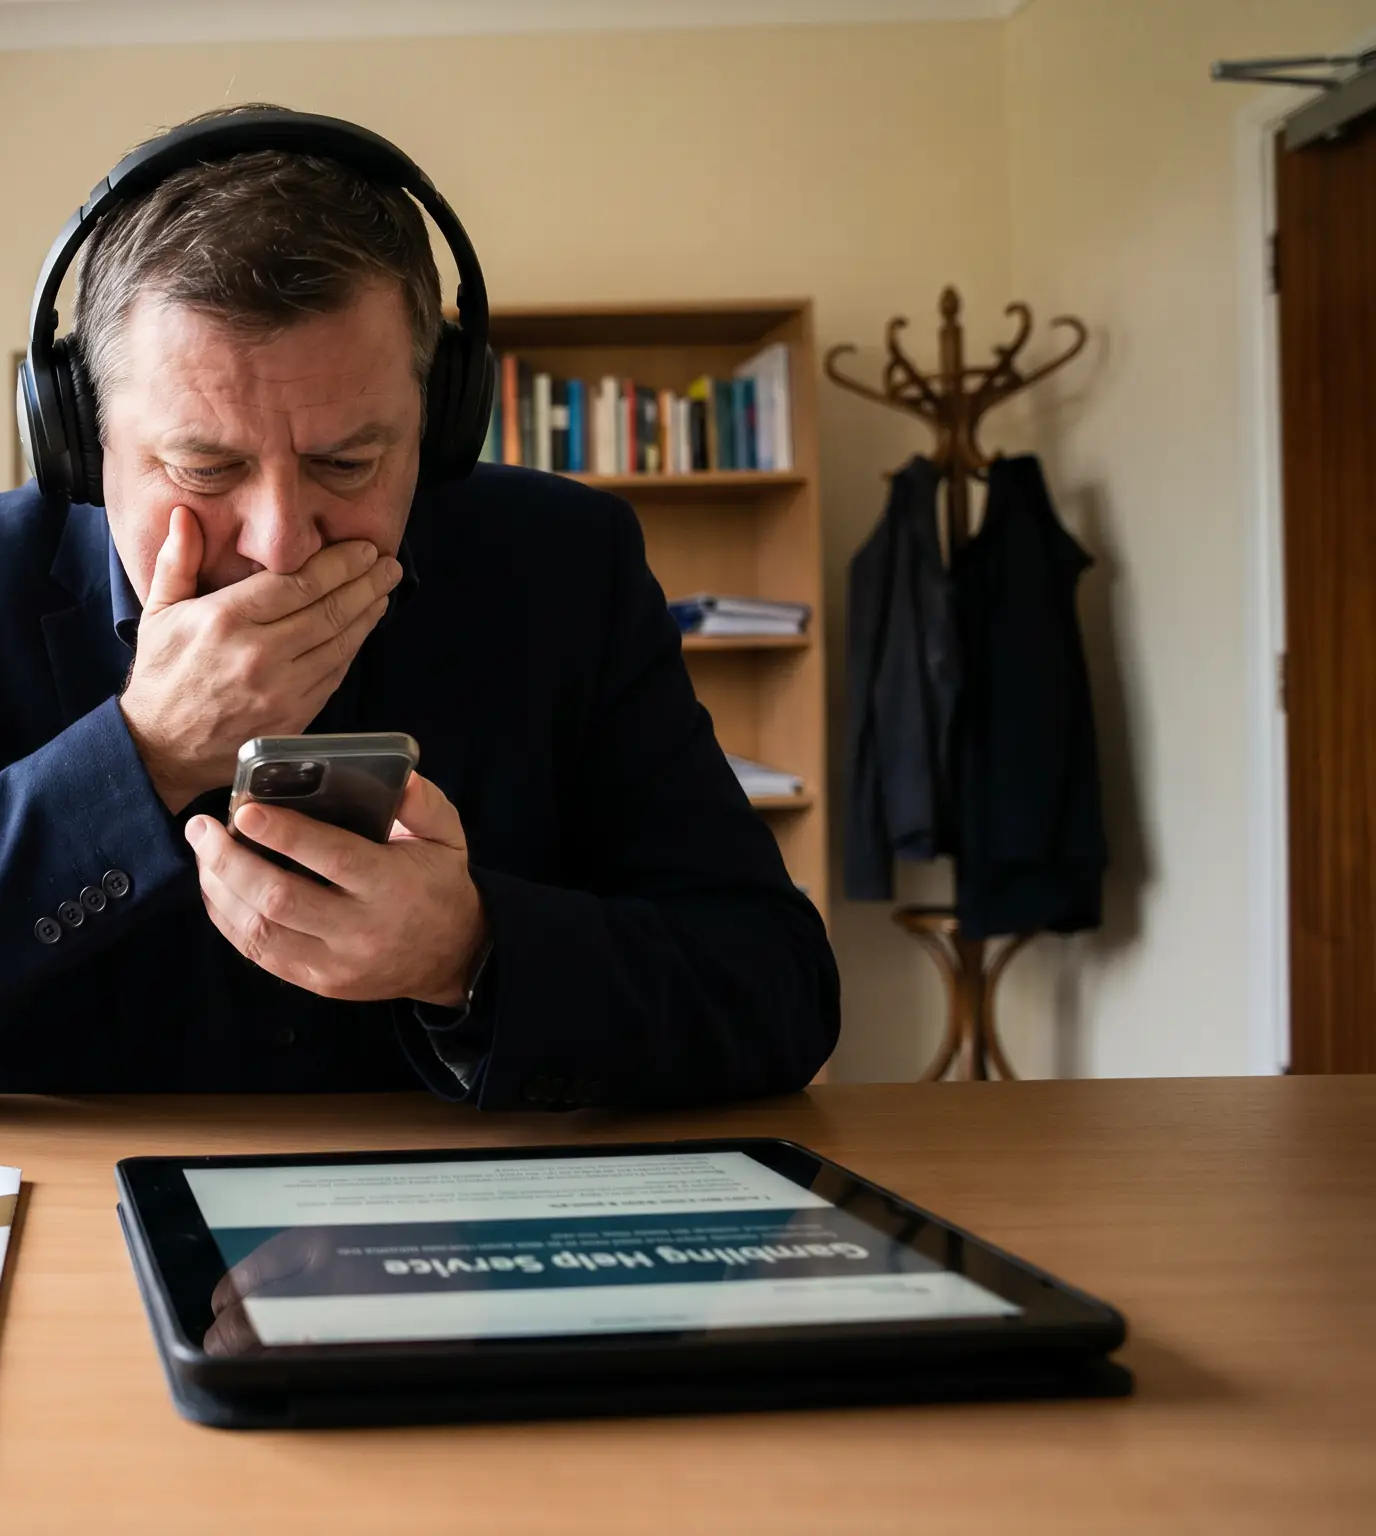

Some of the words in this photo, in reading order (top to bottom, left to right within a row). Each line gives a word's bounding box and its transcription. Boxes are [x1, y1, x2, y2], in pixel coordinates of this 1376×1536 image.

[552, 1249, 653, 1273] Help
[656, 1241, 870, 1266] Gambling
[383, 1255, 544, 1279] Service
